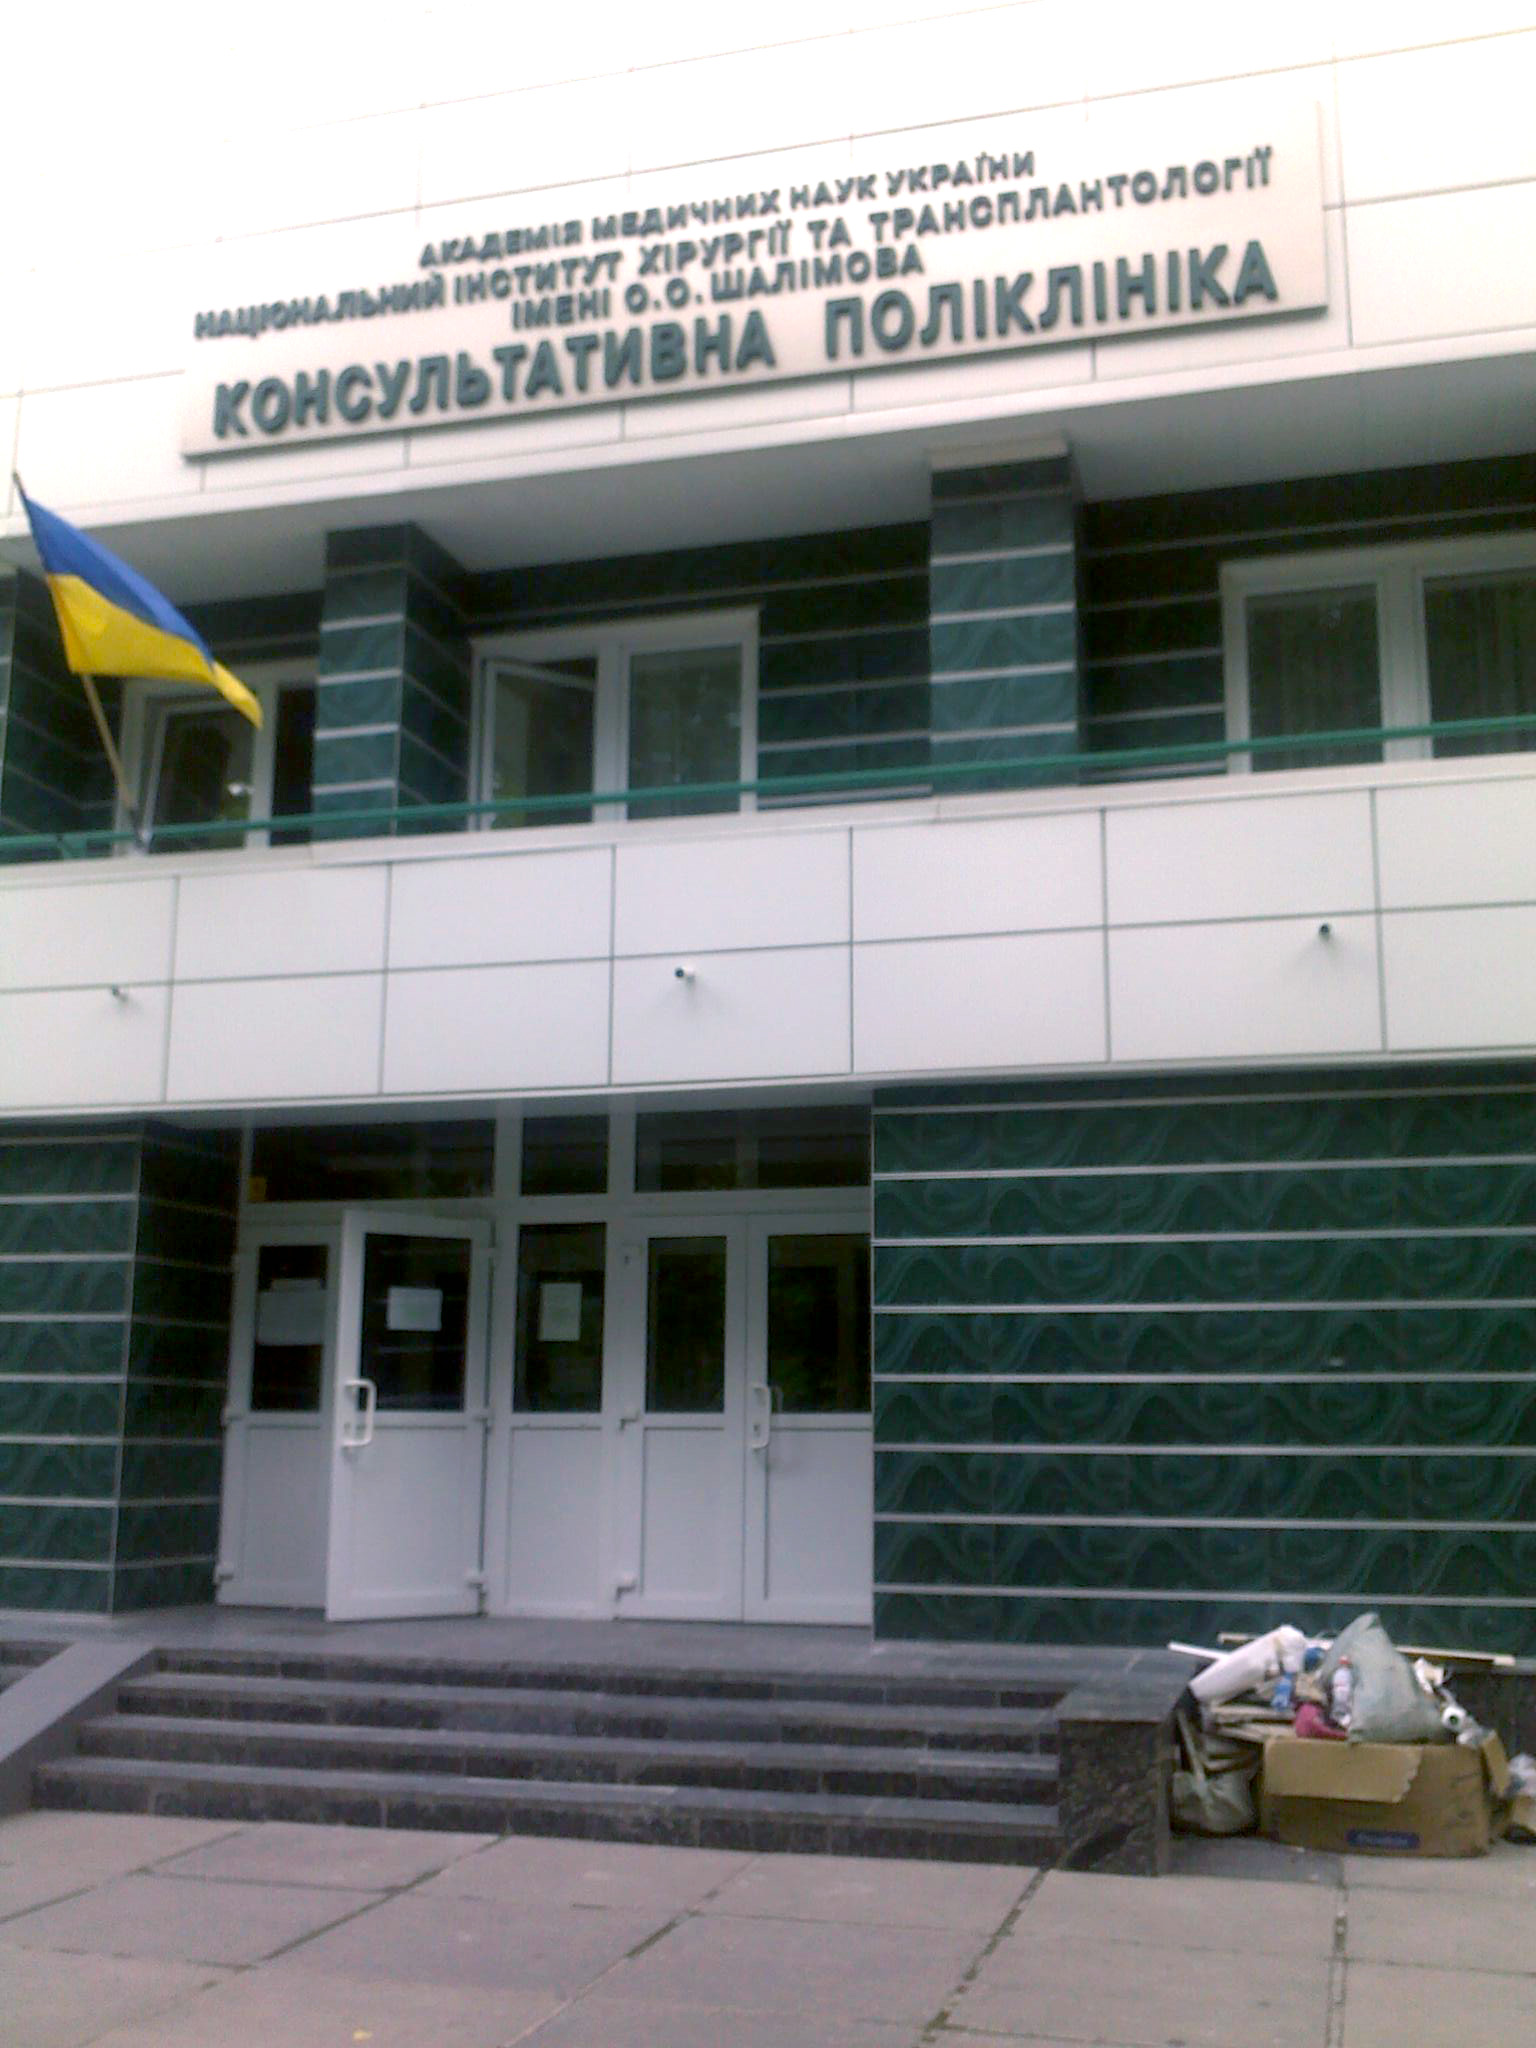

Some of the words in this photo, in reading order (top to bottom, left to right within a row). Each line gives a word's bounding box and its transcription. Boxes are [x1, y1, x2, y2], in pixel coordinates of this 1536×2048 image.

[195, 274, 445, 339] НАЦІОНАЛЬНИЙ
[454, 251, 623, 304] ІНСТИТУТ
[638, 219, 792, 276] ХІРУРГІЇ
[807, 218, 851, 250] ТА
[869, 146, 1272, 242] ТРАНСПЛАНТОЛОГІЇ
[420, 220, 581, 268] АКАДЕМІЯ
[592, 189, 780, 241] МЕДИЧНИХ
[790, 174, 876, 209] НАУК
[886, 151, 1033, 196] УКРАЇНИ
[213, 310, 776, 438] КОНСУЛЬТАТИВНА
[825, 240, 1278, 359] ПОЛІКЛІНІКА
[512, 288, 610, 331] ІМЕНІ
[624, 277, 703, 315] О.О.
[711, 244, 924, 303] ШАЛІМОВА
